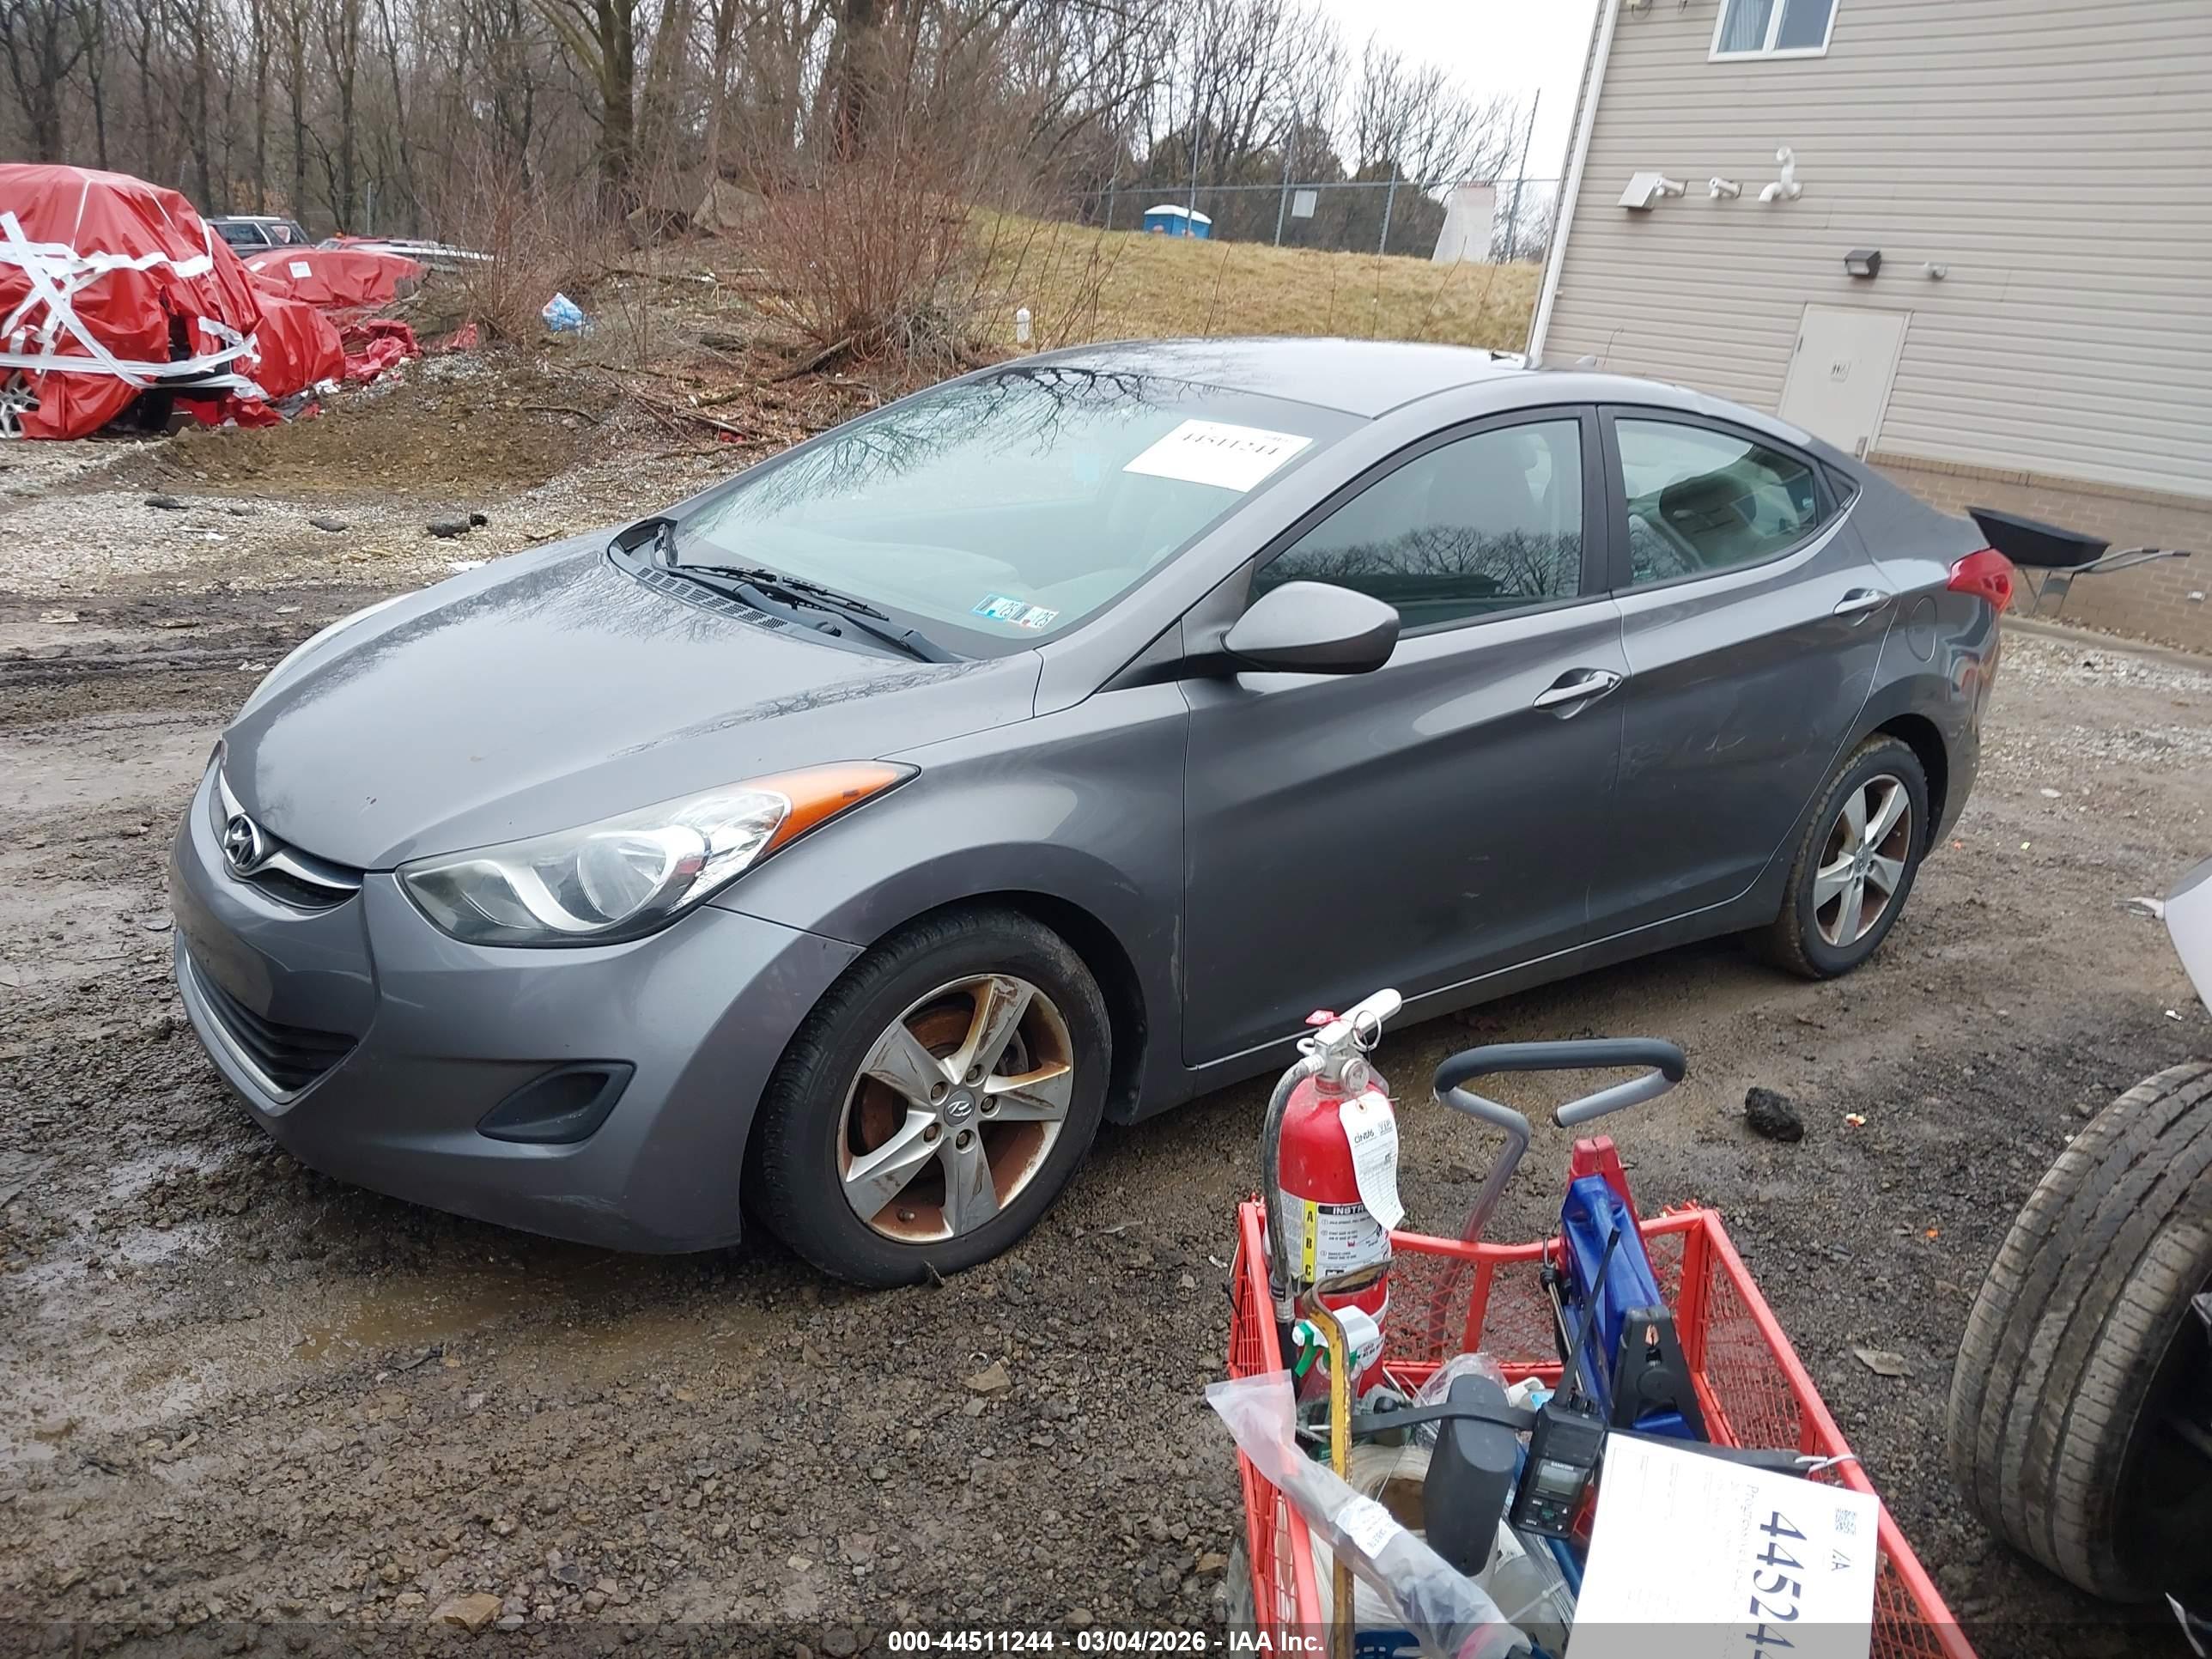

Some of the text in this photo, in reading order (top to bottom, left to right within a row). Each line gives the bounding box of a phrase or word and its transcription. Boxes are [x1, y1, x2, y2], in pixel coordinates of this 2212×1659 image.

[1306, 1211, 1314, 1223] A
[1305, 1237, 1313, 1249] B
[1304, 1264, 1312, 1277] C
